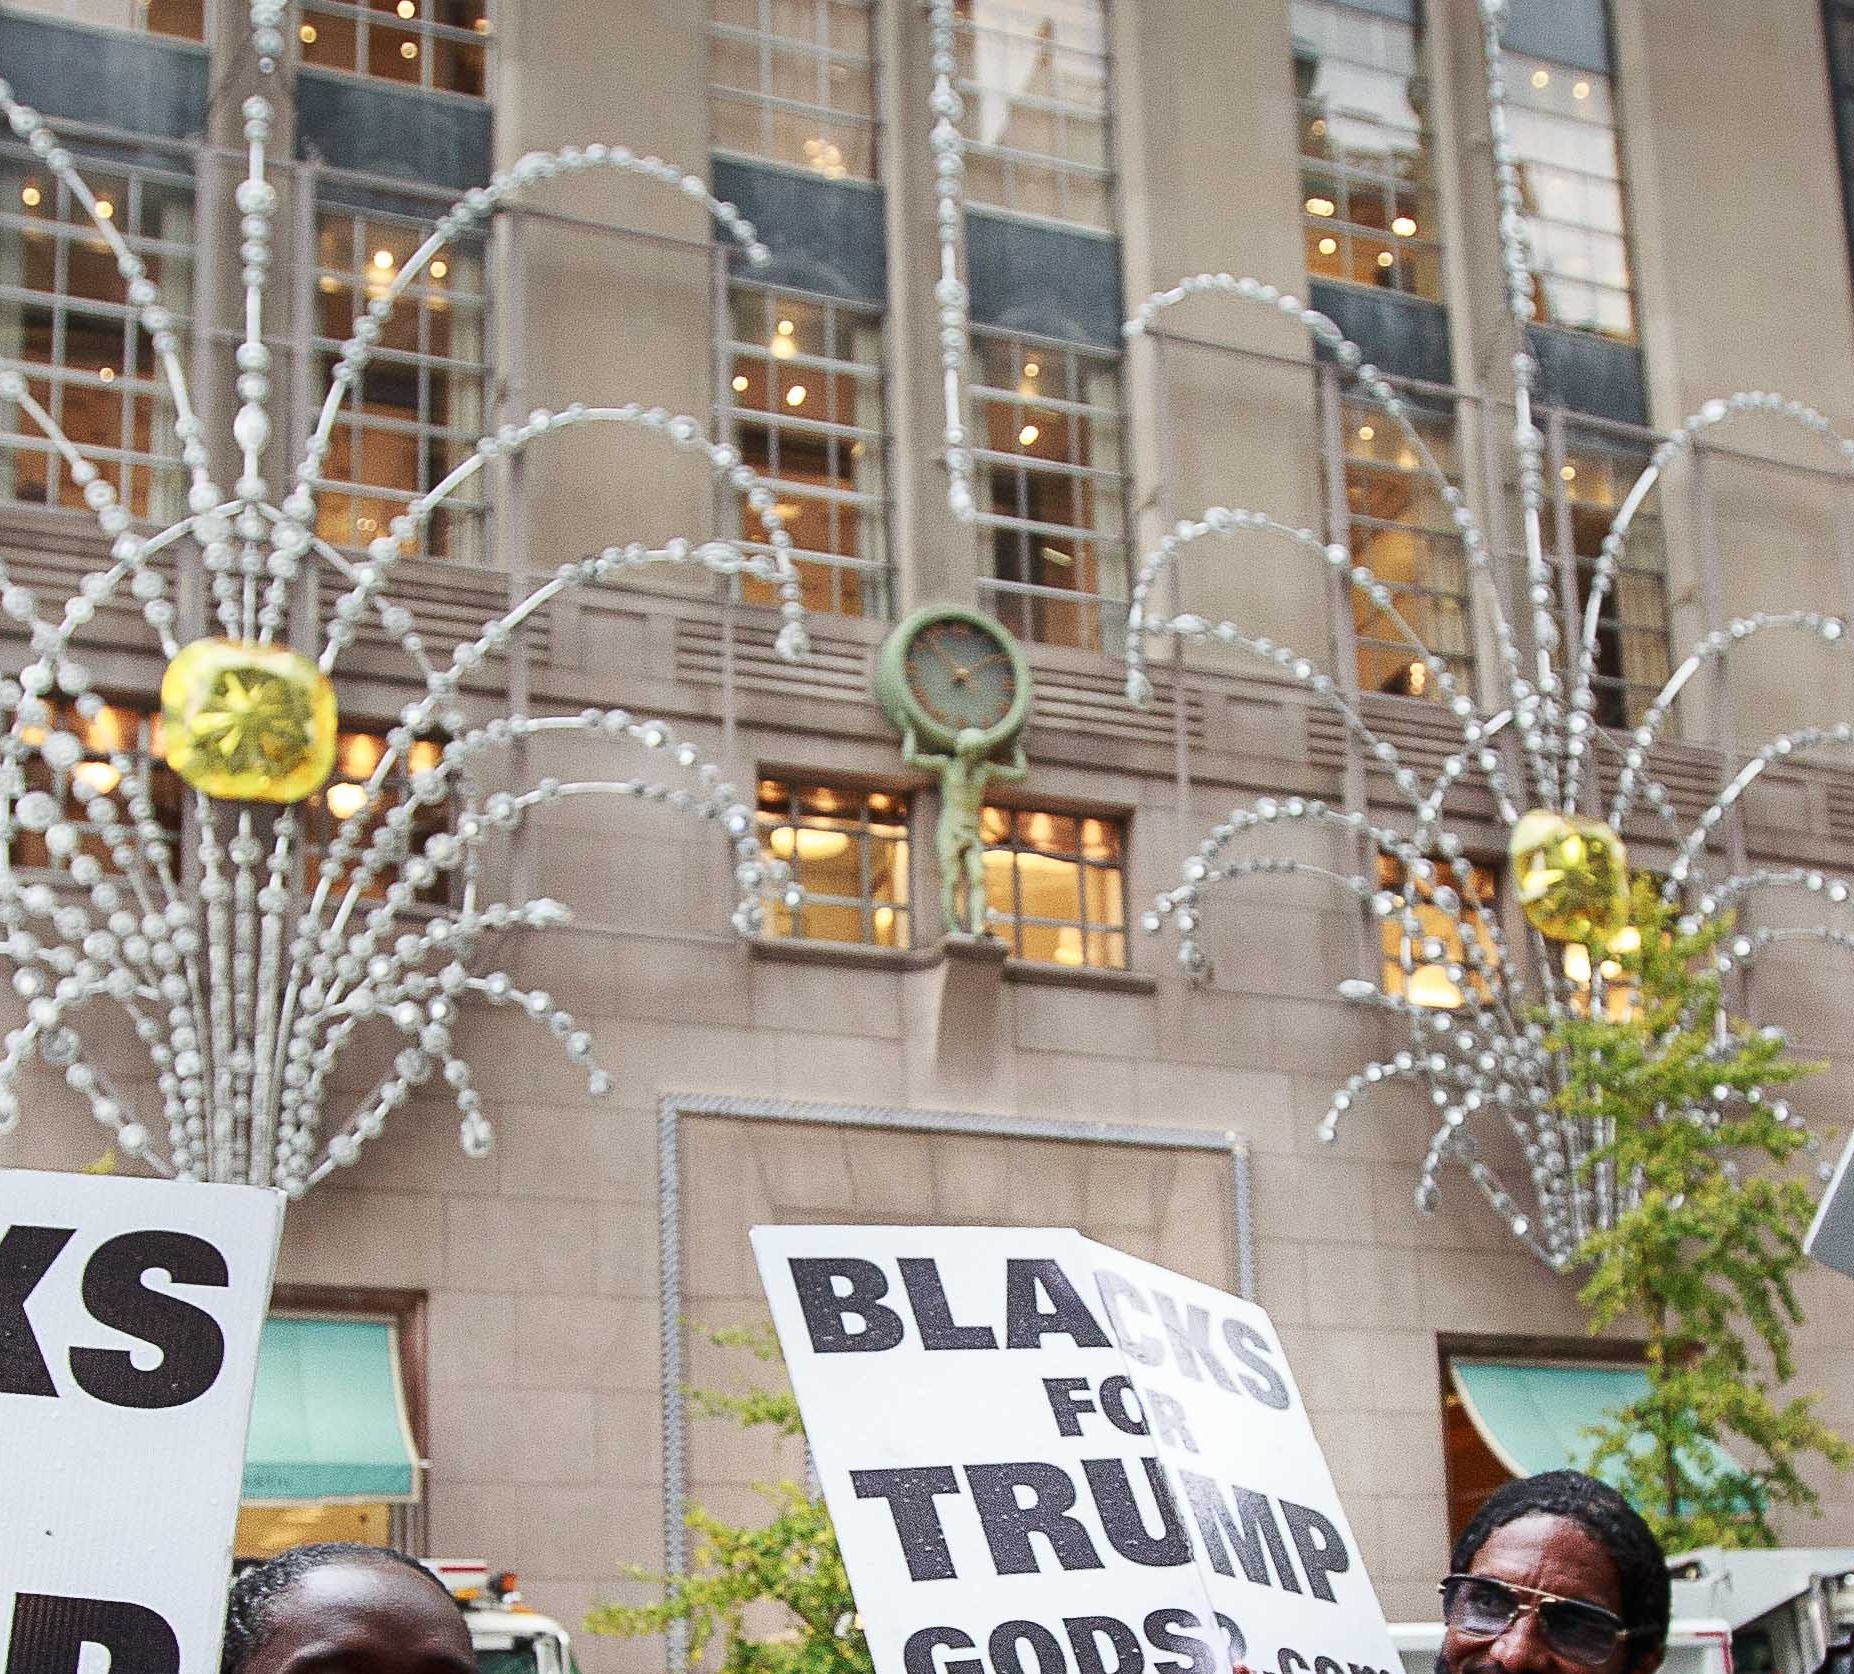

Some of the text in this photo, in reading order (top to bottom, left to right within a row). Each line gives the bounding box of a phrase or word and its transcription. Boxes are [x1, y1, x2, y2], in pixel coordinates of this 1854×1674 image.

[787, 1257, 1292, 1410] BLACKS
[1042, 1375, 1201, 1454] FOR
[848, 1457, 1350, 1604] TRUMP
